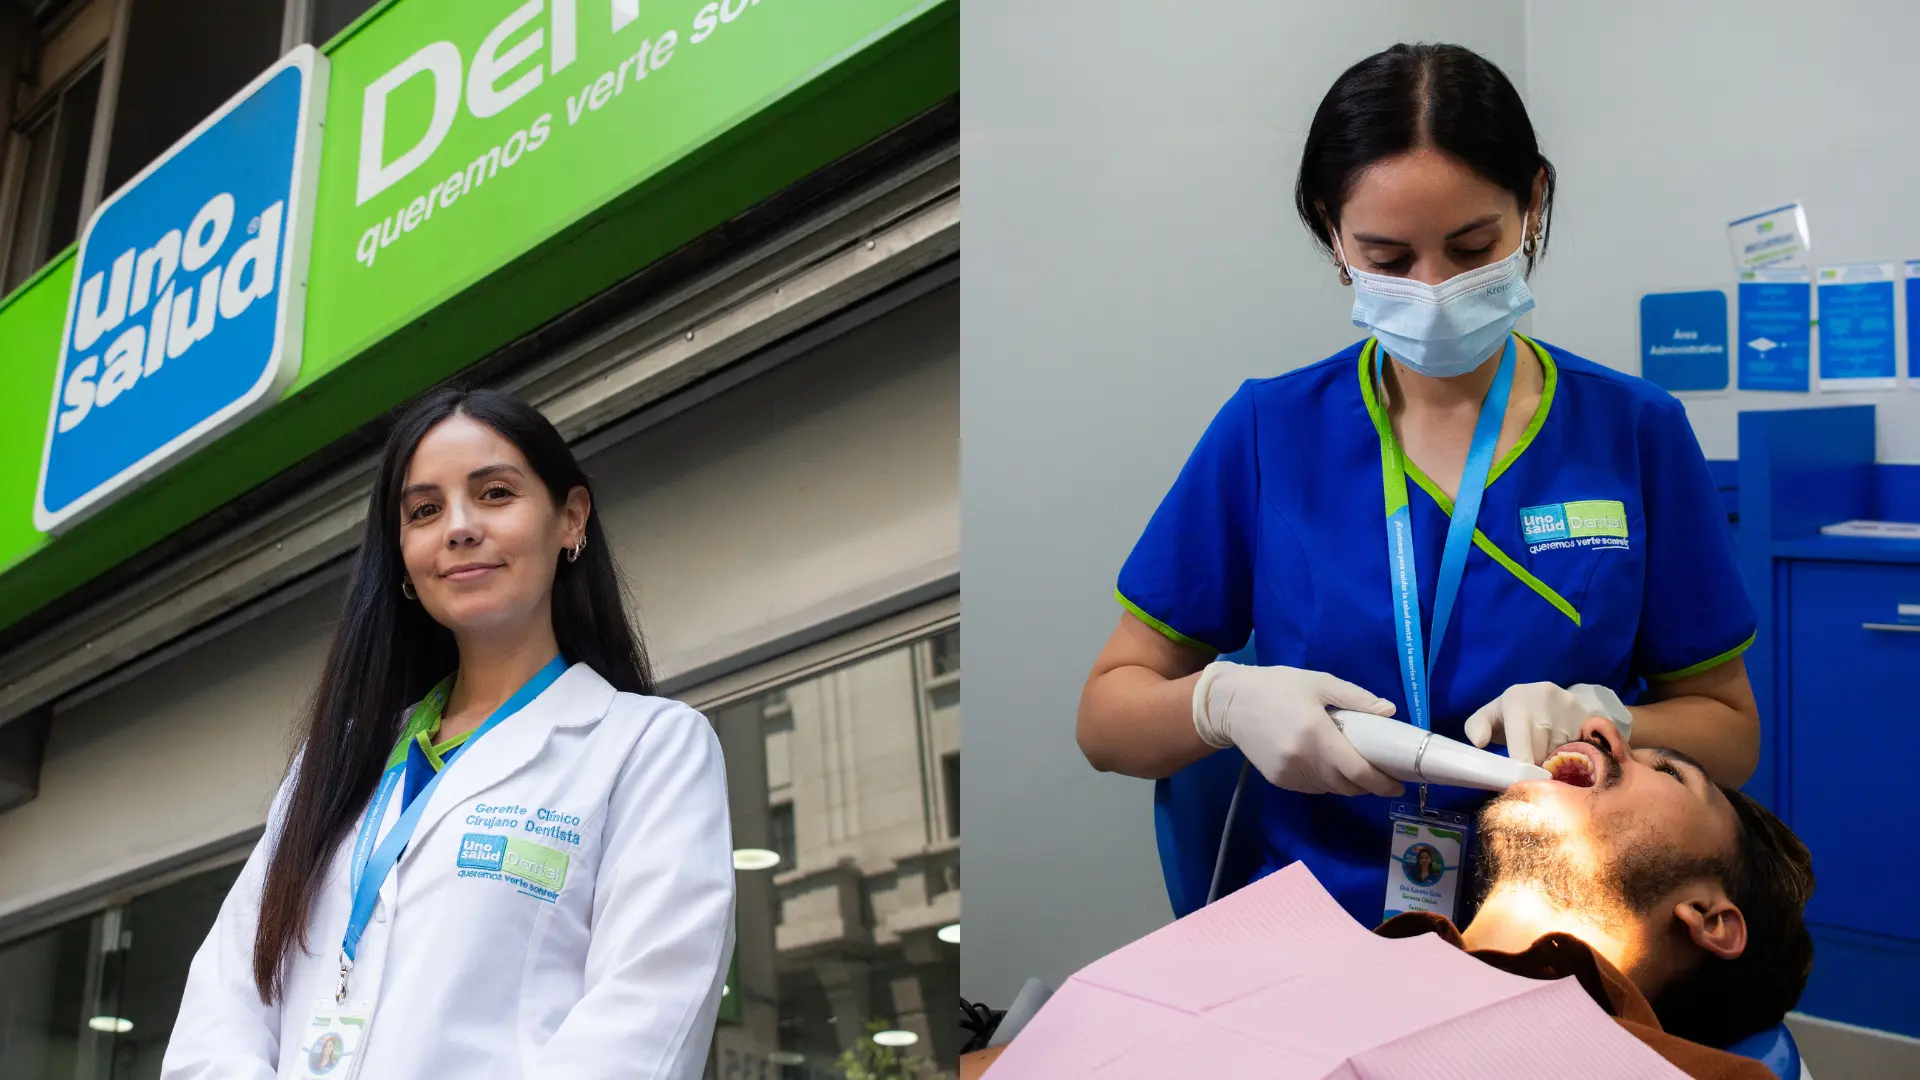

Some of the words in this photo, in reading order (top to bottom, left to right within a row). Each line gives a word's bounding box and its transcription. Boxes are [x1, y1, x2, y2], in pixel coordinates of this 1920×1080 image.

[355, 112, 553, 268] queremos
[566, 29, 678, 126] verte
[689, 0, 762, 44] so
[74, 192, 235, 352] uno
[58, 200, 284, 434] salud
[1525, 520, 1566, 535] salud
[1569, 514, 1624, 529] Dental
[1529, 540, 1575, 554] queremos
[1577, 537, 1600, 547] verte
[1400, 570, 1409, 591] cuidar
[1403, 600, 1412, 619] salud
[1405, 620, 1413, 642] dental
[1408, 655, 1417, 681] sonrisa
[1412, 681, 1418, 690] de
[475, 803, 527, 815] Gerente
[537, 807, 580, 826] Clínico
[465, 814, 518, 829] Cirujano
[525, 820, 580, 845] Dentista
[461, 849, 500, 862] salud
[506, 851, 560, 882] Dental
[457, 870, 503, 881] queremos
[504, 874, 529, 888] verte
